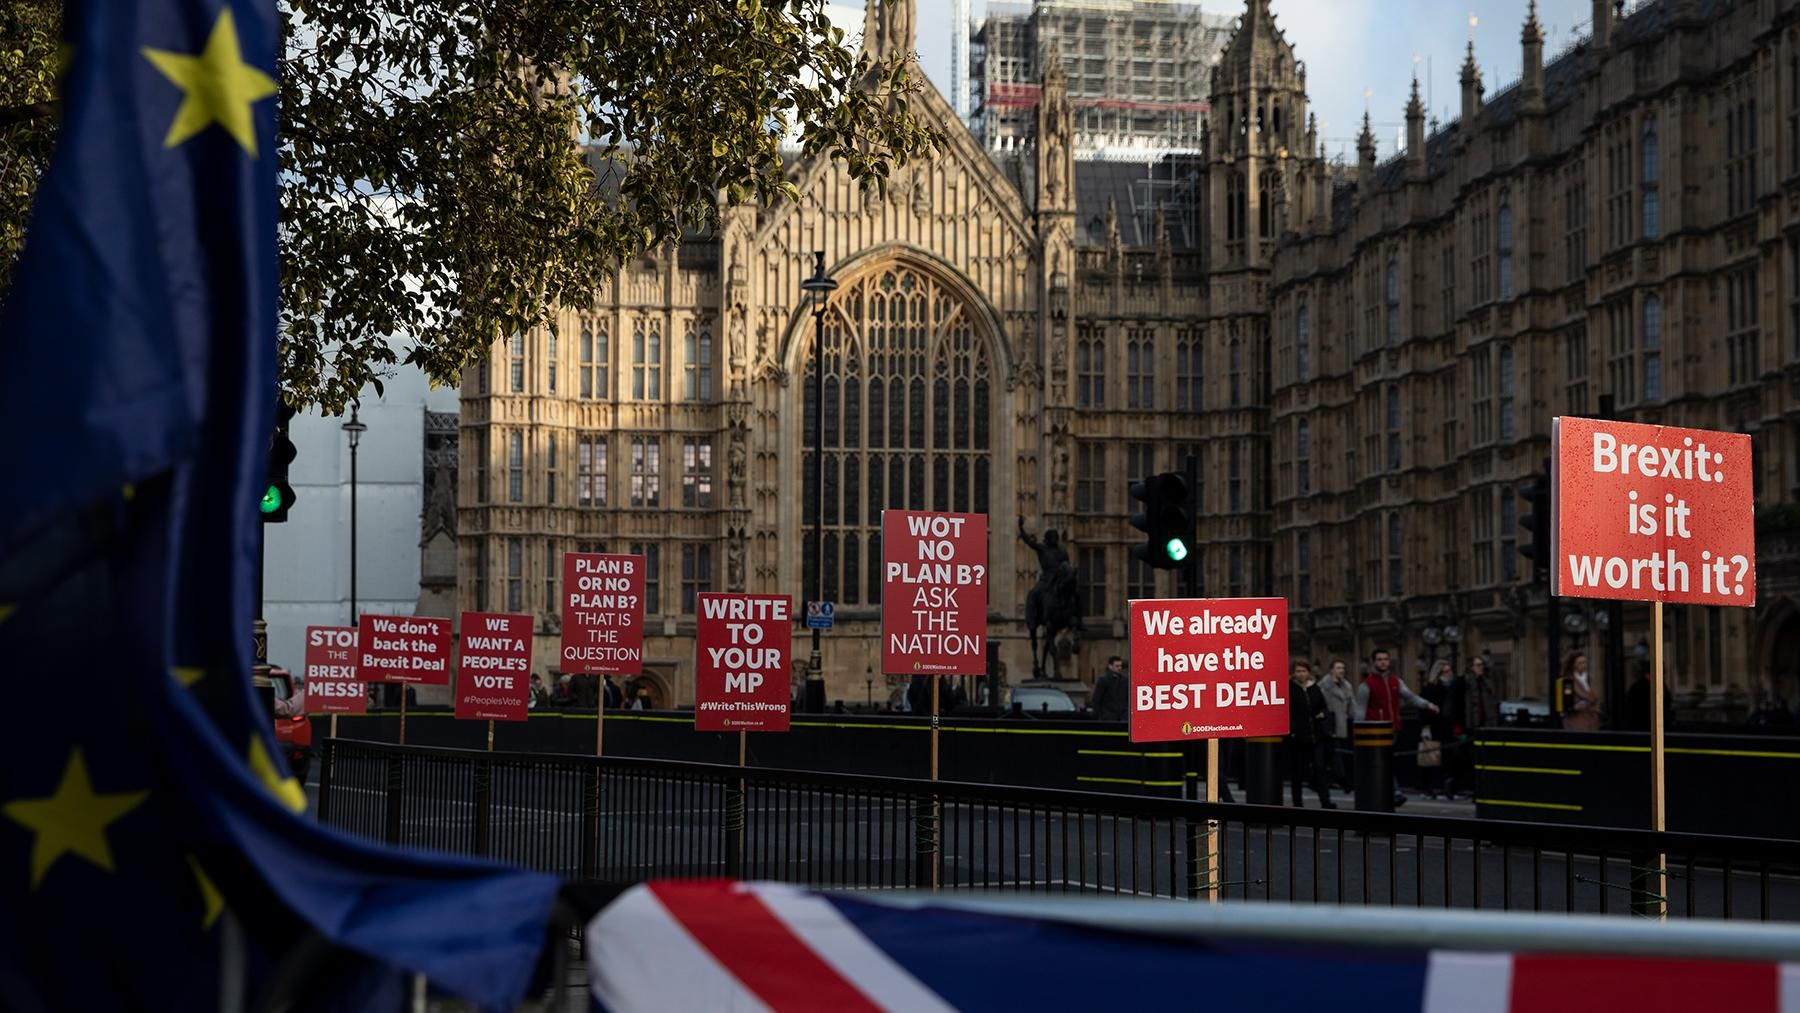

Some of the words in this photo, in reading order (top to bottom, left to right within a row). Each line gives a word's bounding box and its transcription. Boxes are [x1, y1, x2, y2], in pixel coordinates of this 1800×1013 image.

[1593, 432, 1724, 483] Brexit:
[1629, 491, 1658, 536] is
[1665, 493, 1691, 538] it
[907, 516, 965, 538] WOT
[918, 540, 955, 561] NO
[576, 559, 620, 574] PLAN
[623, 561, 634, 574] B
[887, 562, 951, 584] PLAN
[957, 565, 985, 585] B?
[1568, 549, 1690, 592] worth
[1702, 550, 1749, 596] it?
[578, 576, 602, 590] OR
[605, 578, 631, 592] NO
[570, 593, 615, 609] PLAN
[618, 595, 638, 609] B?
[913, 587, 958, 608] ASK
[702, 598, 788, 620] WRITE
[373, 619, 397, 633] We
[400, 621, 439, 636] don't
[486, 618, 509, 632] WE
[575, 611, 615, 626] THAT
[618, 613, 631, 627] IS
[912, 610, 959, 631] THE
[1142, 610, 1184, 636] We
[1189, 608, 1277, 640] already
[587, 629, 618, 643] THE
[726, 623, 764, 645] TO
[373, 637, 409, 652] back
[411, 639, 437, 653] the
[467, 636, 512, 651] WANT
[513, 639, 525, 652] A
[891, 633, 979, 655] NATION
[327, 651, 348, 660] THE
[564, 646, 640, 661] QUESTION
[707, 647, 781, 669] YOUR
[1158, 648, 1218, 673] have
[1222, 645, 1264, 671] the
[362, 654, 409, 670] Brexit
[412, 657, 445, 671] Deal
[462, 655, 527, 671] PEOPLE'S
[308, 664, 357, 679] BREXI
[308, 682, 364, 697] MESS!
[473, 675, 514, 689] VOTE
[725, 672, 764, 693] MP
[464, 696, 521, 706] #PeoplesVote
[1136, 684, 1206, 711] BEST
[1216, 681, 1285, 708] DEAL
[700, 702, 787, 712] #WriteThisWrong
